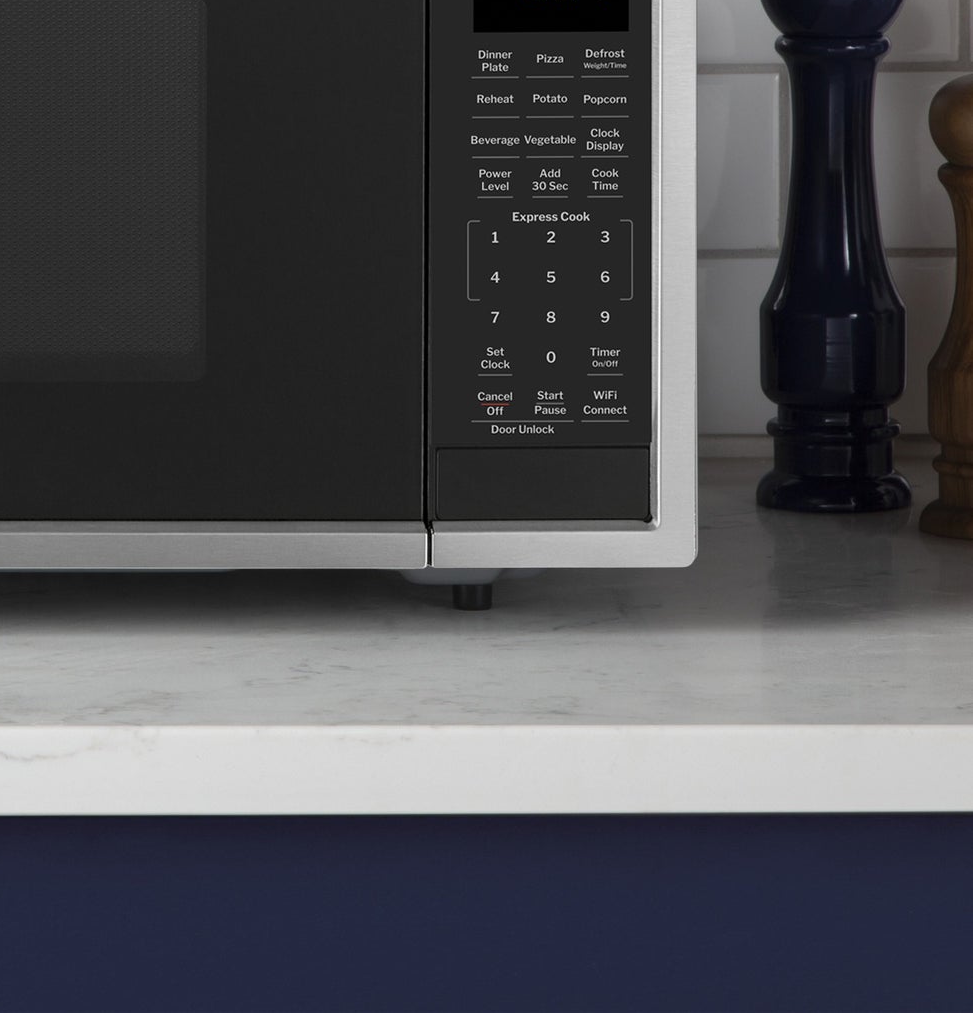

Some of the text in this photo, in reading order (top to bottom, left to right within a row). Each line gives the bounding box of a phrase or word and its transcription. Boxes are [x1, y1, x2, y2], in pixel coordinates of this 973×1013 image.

[477, 49, 513, 60] Dinner
[536, 53, 564, 64] Pizza
[585, 48, 625, 59] Defrost
[481, 62, 510, 72] Plate
[583, 61, 628, 70] Weight/Time
[476, 93, 515, 104] Reheat
[532, 93, 568, 104] Potato
[583, 94, 628, 106] Popcorn
[590, 127, 620, 138] Clock
[470, 135, 521, 147] Beverage
[523, 134, 577, 147] Vegetable
[586, 140, 625, 153] Display
[478, 168, 513, 179] Power
[539, 168, 561, 179] Add
[591, 168, 620, 178] Cook
[481, 181, 510, 192] Level
[531, 180, 569, 191] 30 Sec
[591, 180, 619, 191] Time
[512, 211, 591, 224] Express Cook
[491, 231, 500, 244] 1
[546, 230, 556, 244] 2
[600, 230, 610, 244] 3
[490, 271, 501, 284] 4
[546, 270, 557, 284] 5
[600, 270, 611, 284] 6
[490, 311, 500, 324] 7
[546, 310, 557, 324] 8
[600, 310, 611, 324] 9
[486, 346, 505, 357] Set
[545, 350, 557, 364] 0
[589, 346, 621, 357] Timer
[480, 359, 511, 370] Clock
[591, 359, 619, 368] On/Off
[477, 391, 513, 402] Cancel
[537, 390, 564, 401] Start
[593, 390, 618, 400] WiFi
[486, 405, 504, 416] Off
[534, 405, 567, 415] Pause
[582, 404, 628, 415] Connect
[490, 424, 555, 435] Door Unlock
